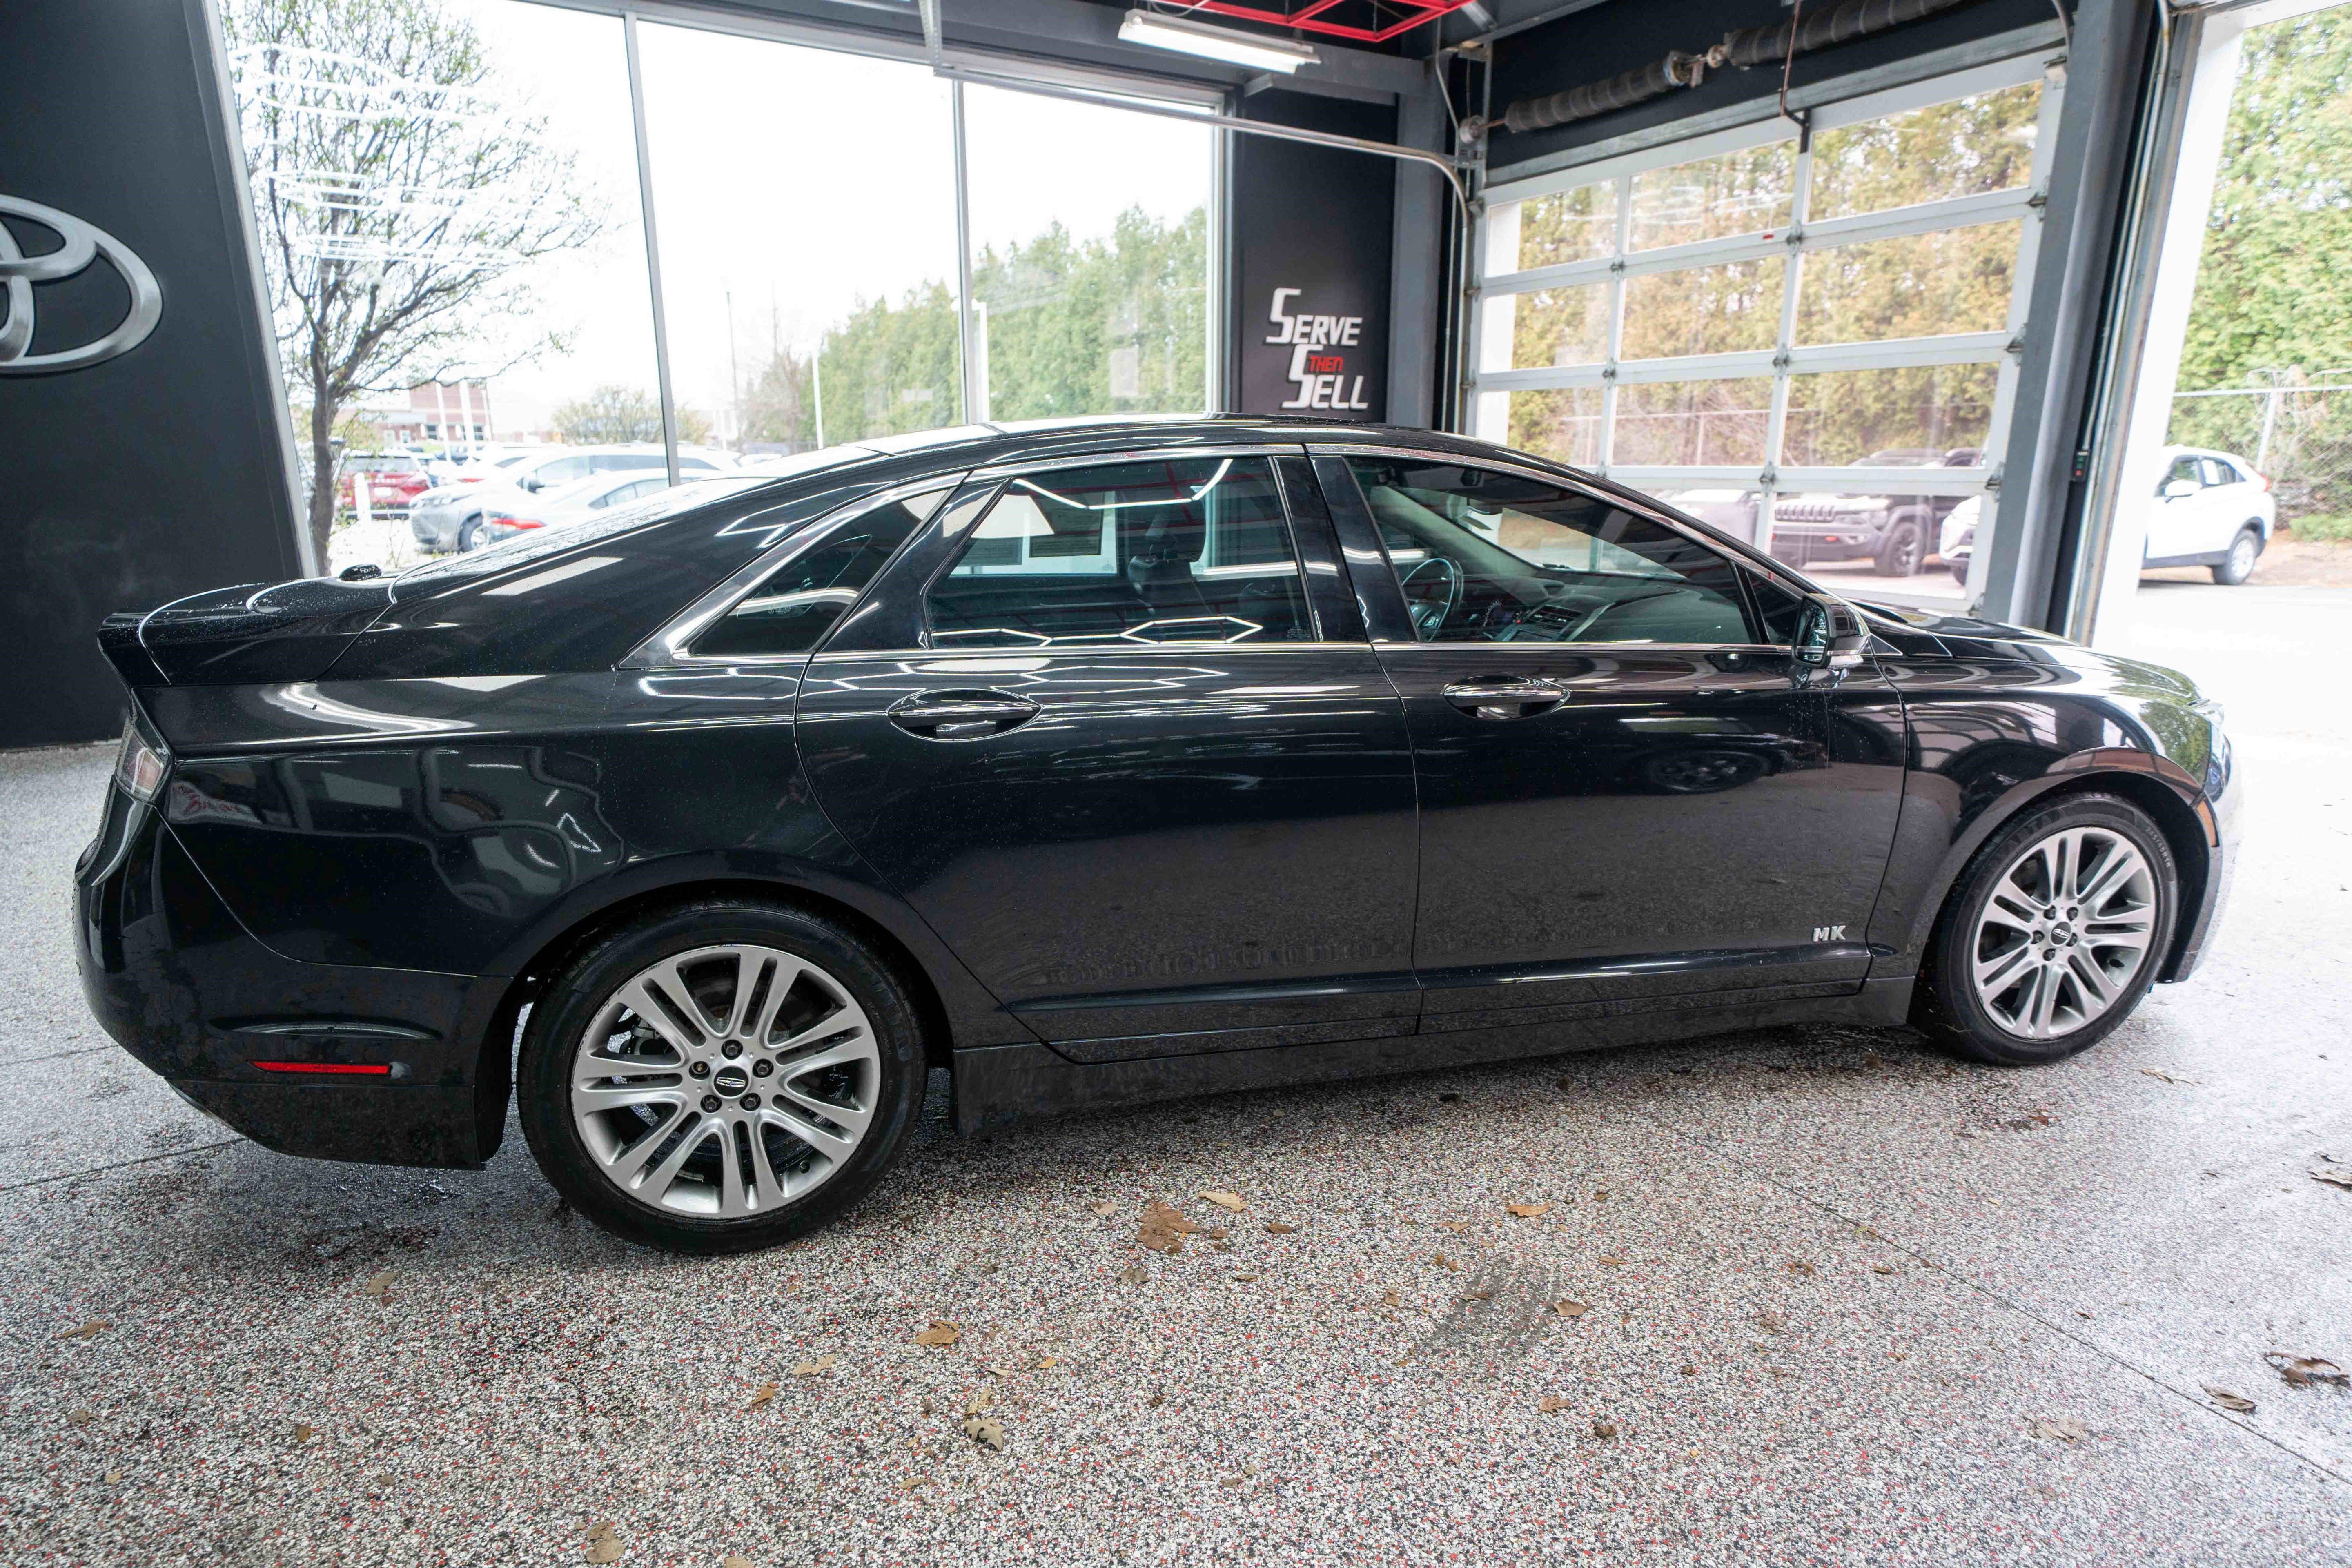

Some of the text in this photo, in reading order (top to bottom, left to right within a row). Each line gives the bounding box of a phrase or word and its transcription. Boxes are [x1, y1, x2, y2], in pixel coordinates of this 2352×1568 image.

[1266, 287, 1363, 346] SERVE
[1281, 344, 1368, 409] SELL
[1309, 356, 1343, 372] THEN
[1812, 925, 1846, 942] MK
